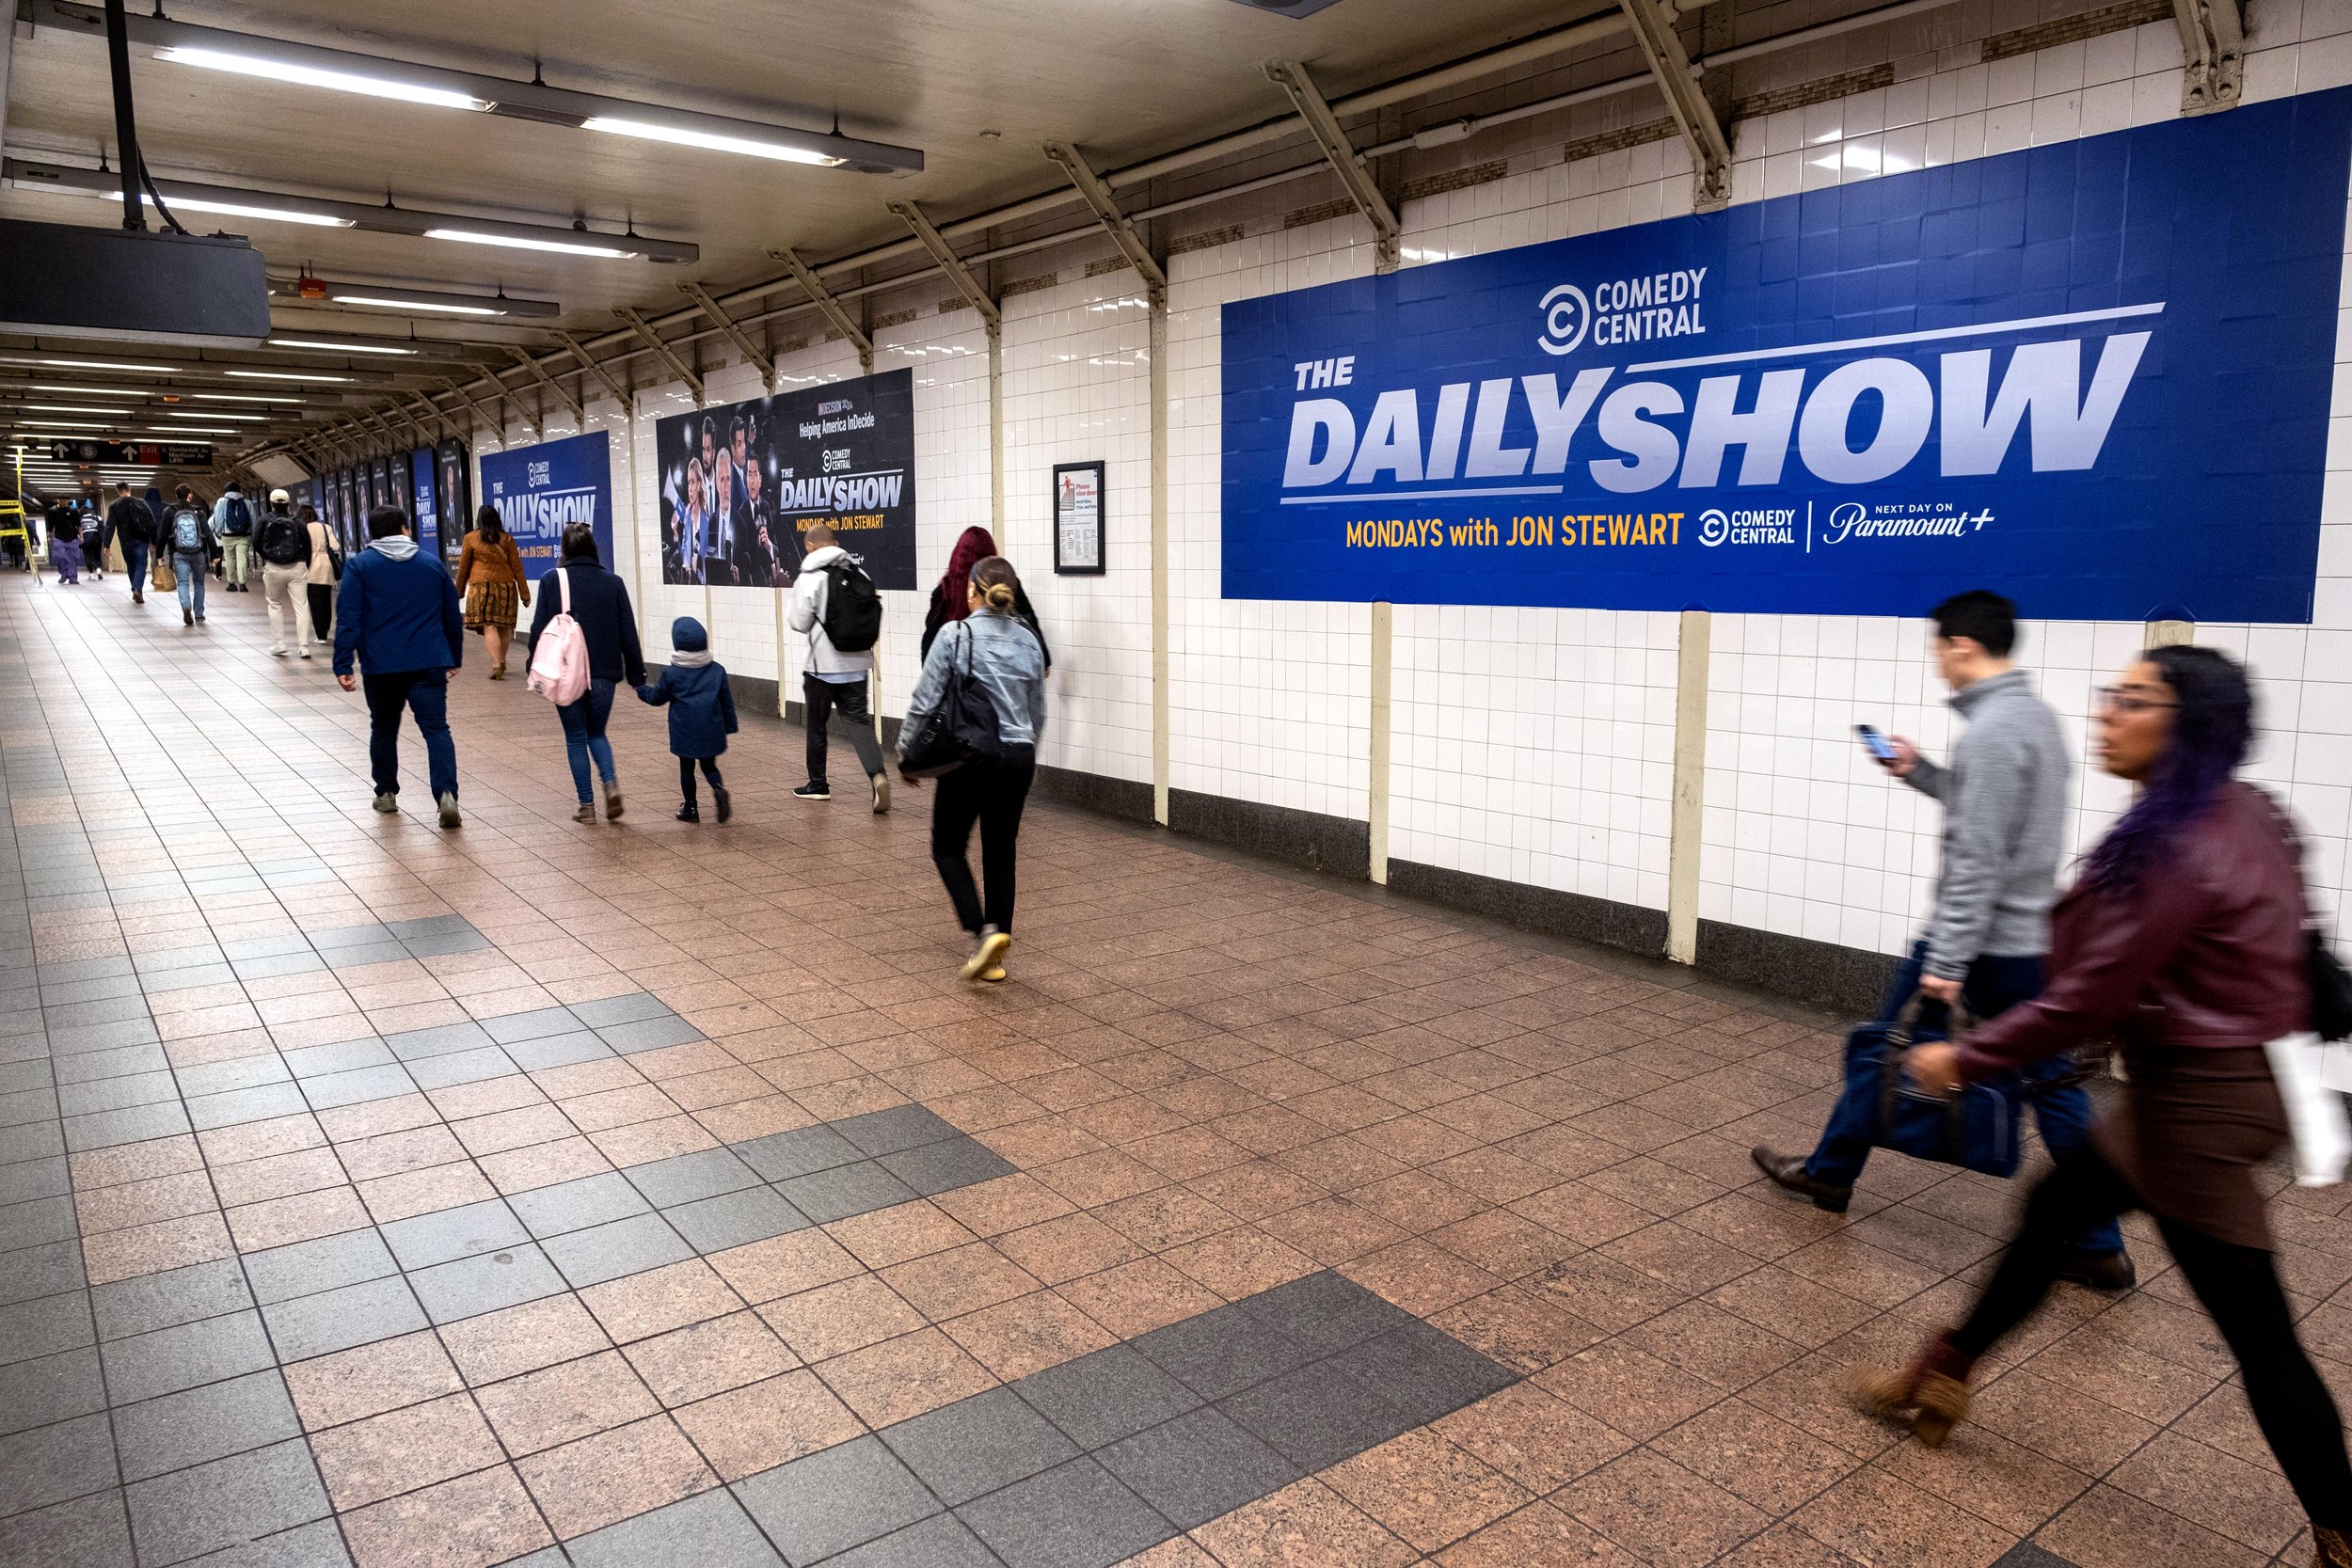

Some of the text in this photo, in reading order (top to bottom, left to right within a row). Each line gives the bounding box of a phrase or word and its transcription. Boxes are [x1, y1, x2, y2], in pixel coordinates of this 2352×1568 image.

[1595, 267, 1708, 313] COMEDY
[1594, 304, 1707, 346] CENTRAL
[1295, 356, 1356, 390] THE
[1281, 330, 2153, 494] DAILY SHOW
[799, 411, 874, 440] Helping America InDecide
[139, 445, 157, 453] Exit
[832, 448, 851, 460] COMEDY
[780, 468, 794, 479] THE
[832, 459, 851, 470] CENTRAL
[493, 482, 503, 495] THE
[780, 475, 903, 511] DAILY SHOW
[1875, 503, 1954, 514] NEXT DAY ON
[841, 516, 853, 531] JON
[854, 514, 884, 530] STEWART
[1731, 509, 1796, 528] COMEDY
[1822, 502, 1995, 545] Paramount+
[1345, 513, 1685, 548] MONDAYS with JON STEWART
[1730, 526, 1795, 545] CENTRAL
